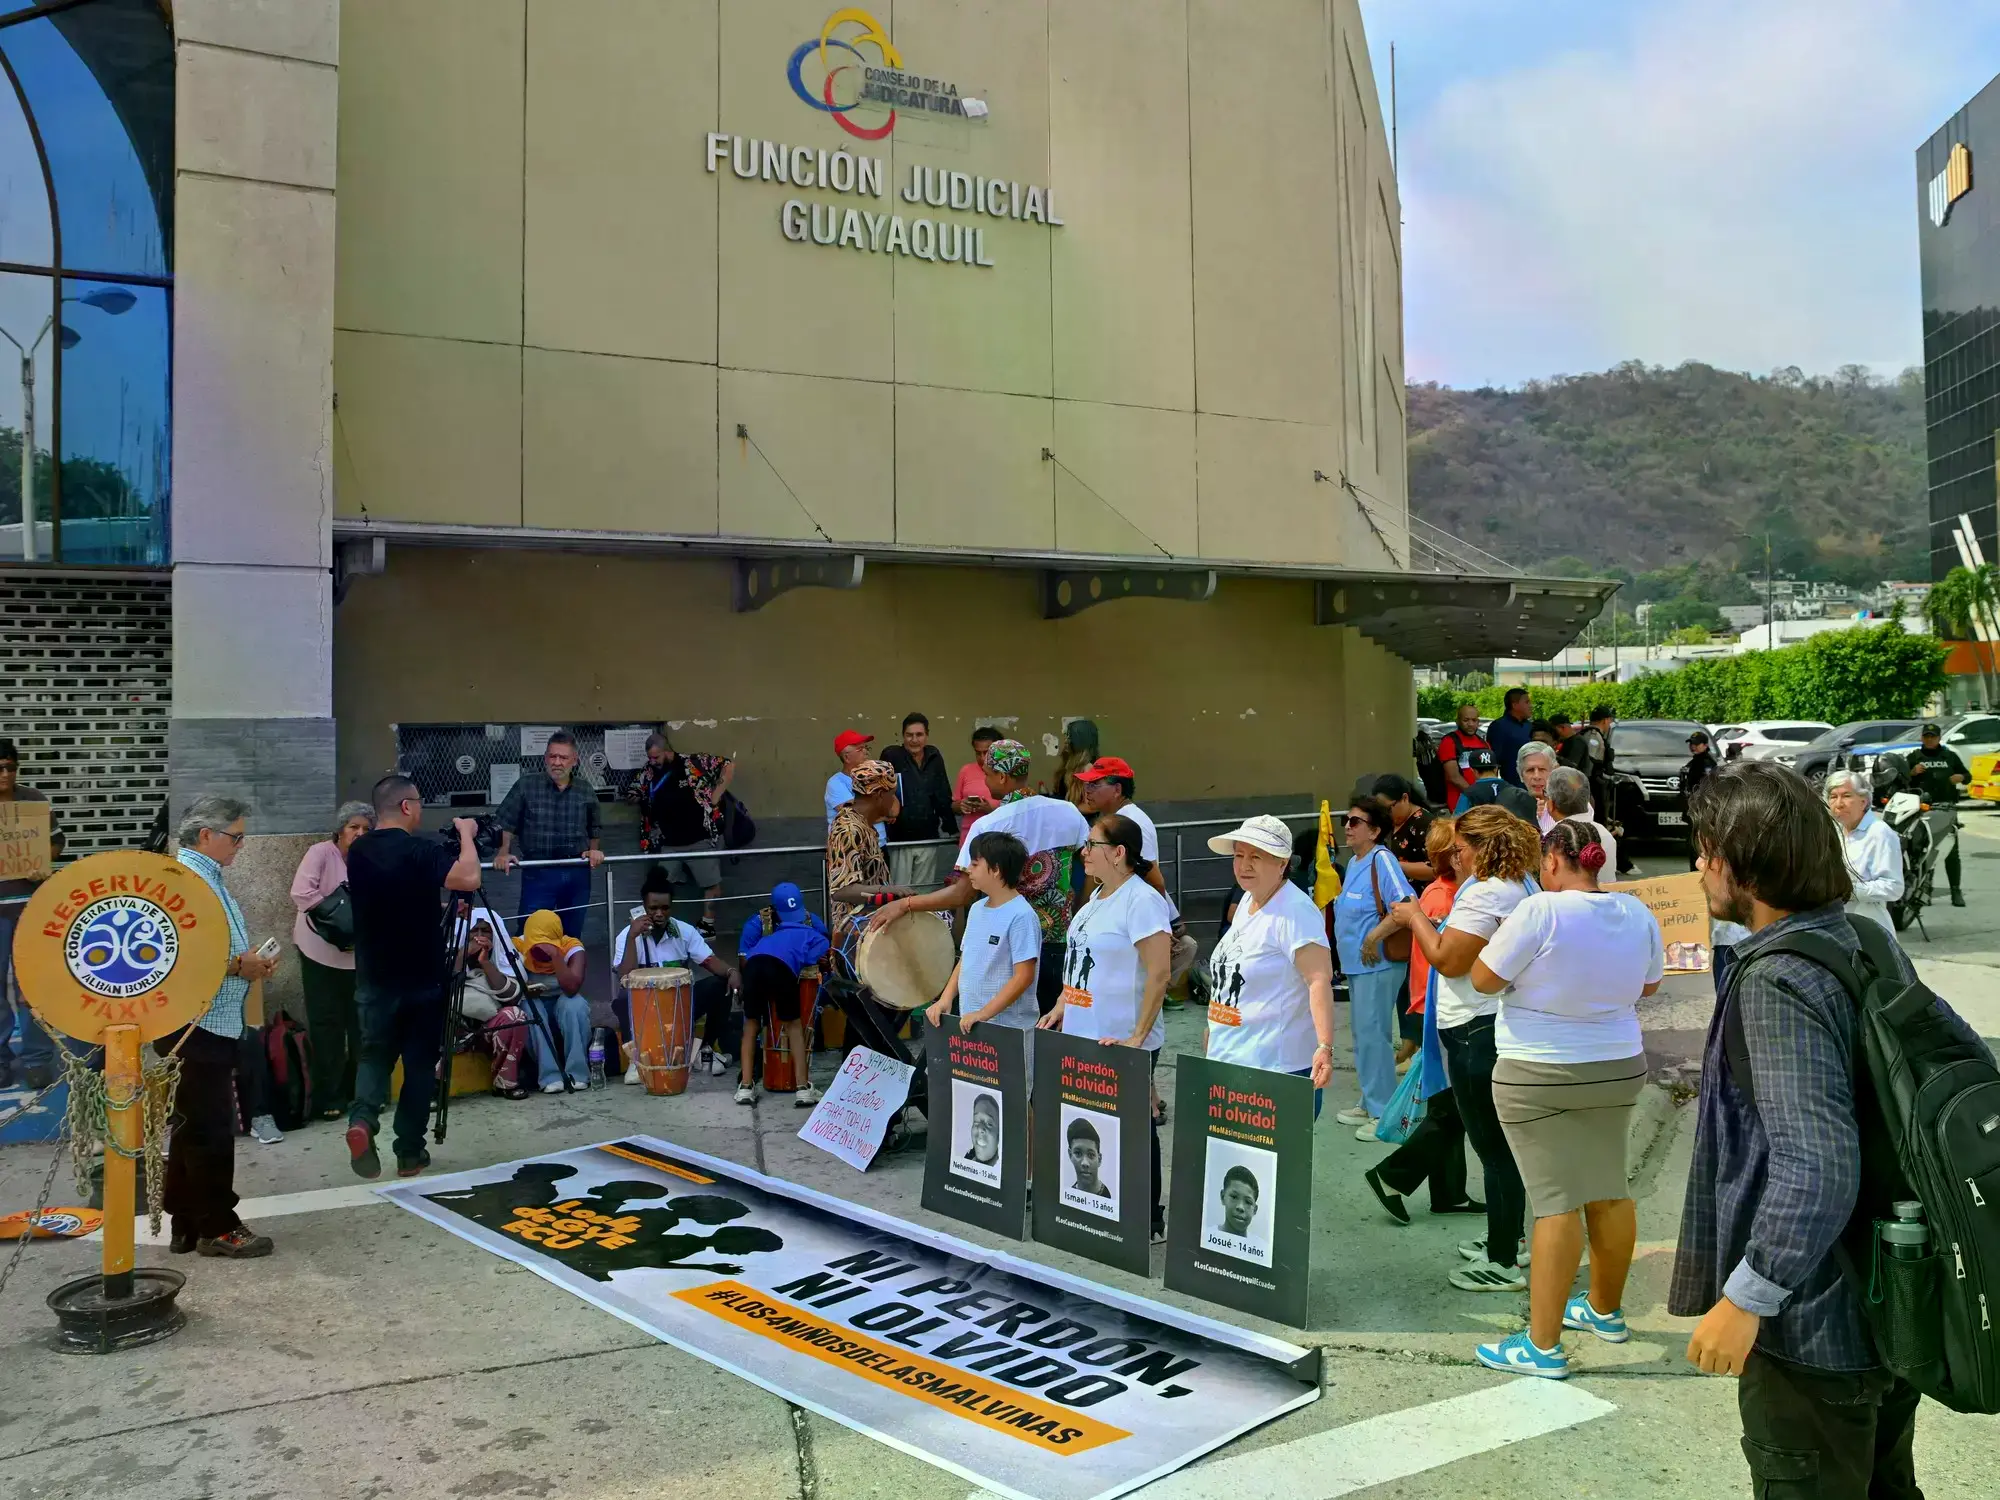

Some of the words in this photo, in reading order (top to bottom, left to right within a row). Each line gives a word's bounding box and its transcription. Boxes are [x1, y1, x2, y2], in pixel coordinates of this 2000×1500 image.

[864, 66, 921, 90] CONSEJO
[923, 78, 940, 94] DE
[942, 82, 958, 97] LA
[859, 82, 963, 116] JUDICATURA
[705, 132, 885, 198] FUNCIÓN
[901, 165, 1065, 226] JUDICIAL
[781, 200, 995, 267] GUAYAQUIL
[6, 841, 31, 859] NI
[0, 854, 43, 876] LVIDO
[43, 875, 197, 938] RESERVADO
[68, 899, 137, 959] COOPERATIVA
[140, 903, 159, 918] DE
[157, 916, 175, 953] TAXIS
[81, 973, 122, 994] ALBAN
[124, 970, 165, 994] BORJA
[80, 990, 169, 1020] TAXIS
[948, 1035, 961, 1048] ¡Ni
[962, 1039, 998, 1057] perdón,
[950, 1050, 960, 1064] ni
[962, 1053, 999, 1073] olvido!
[1061, 1055, 1075, 1070] ¡Ni
[1077, 1061, 1119, 1081] perdón,
[1061, 1072, 1073, 1087] ni
[1075, 1075, 1118, 1098] olvido!
[1208, 1084, 1226, 1101] ¡Ni
[1227, 1090, 1277, 1113] perdón,
[1208, 1103, 1222, 1119] ni
[1225, 1106, 1276, 1131] olvido!
[982, 1169, 987, 1178] 15
[1064, 1191, 1087, 1206] Ismael
[1092, 1199, 1099, 1209] 15
[1100, 1202, 1114, 1214] años
[501, 1219, 585, 1250] ECU
[1207, 1233, 1232, 1249] Josué
[1239, 1242, 1247, 1253] 14
[1247, 1246, 1264, 1258] años
[823, 1249, 922, 1283] NI
[896, 1276, 1203, 1399] PERDÓN,
[770, 1271, 873, 1310] NI
[848, 1301, 1129, 1408] OLVIDO
[704, 1289, 1084, 1445] #LOS4NIÑOSDELASMALVINAS
